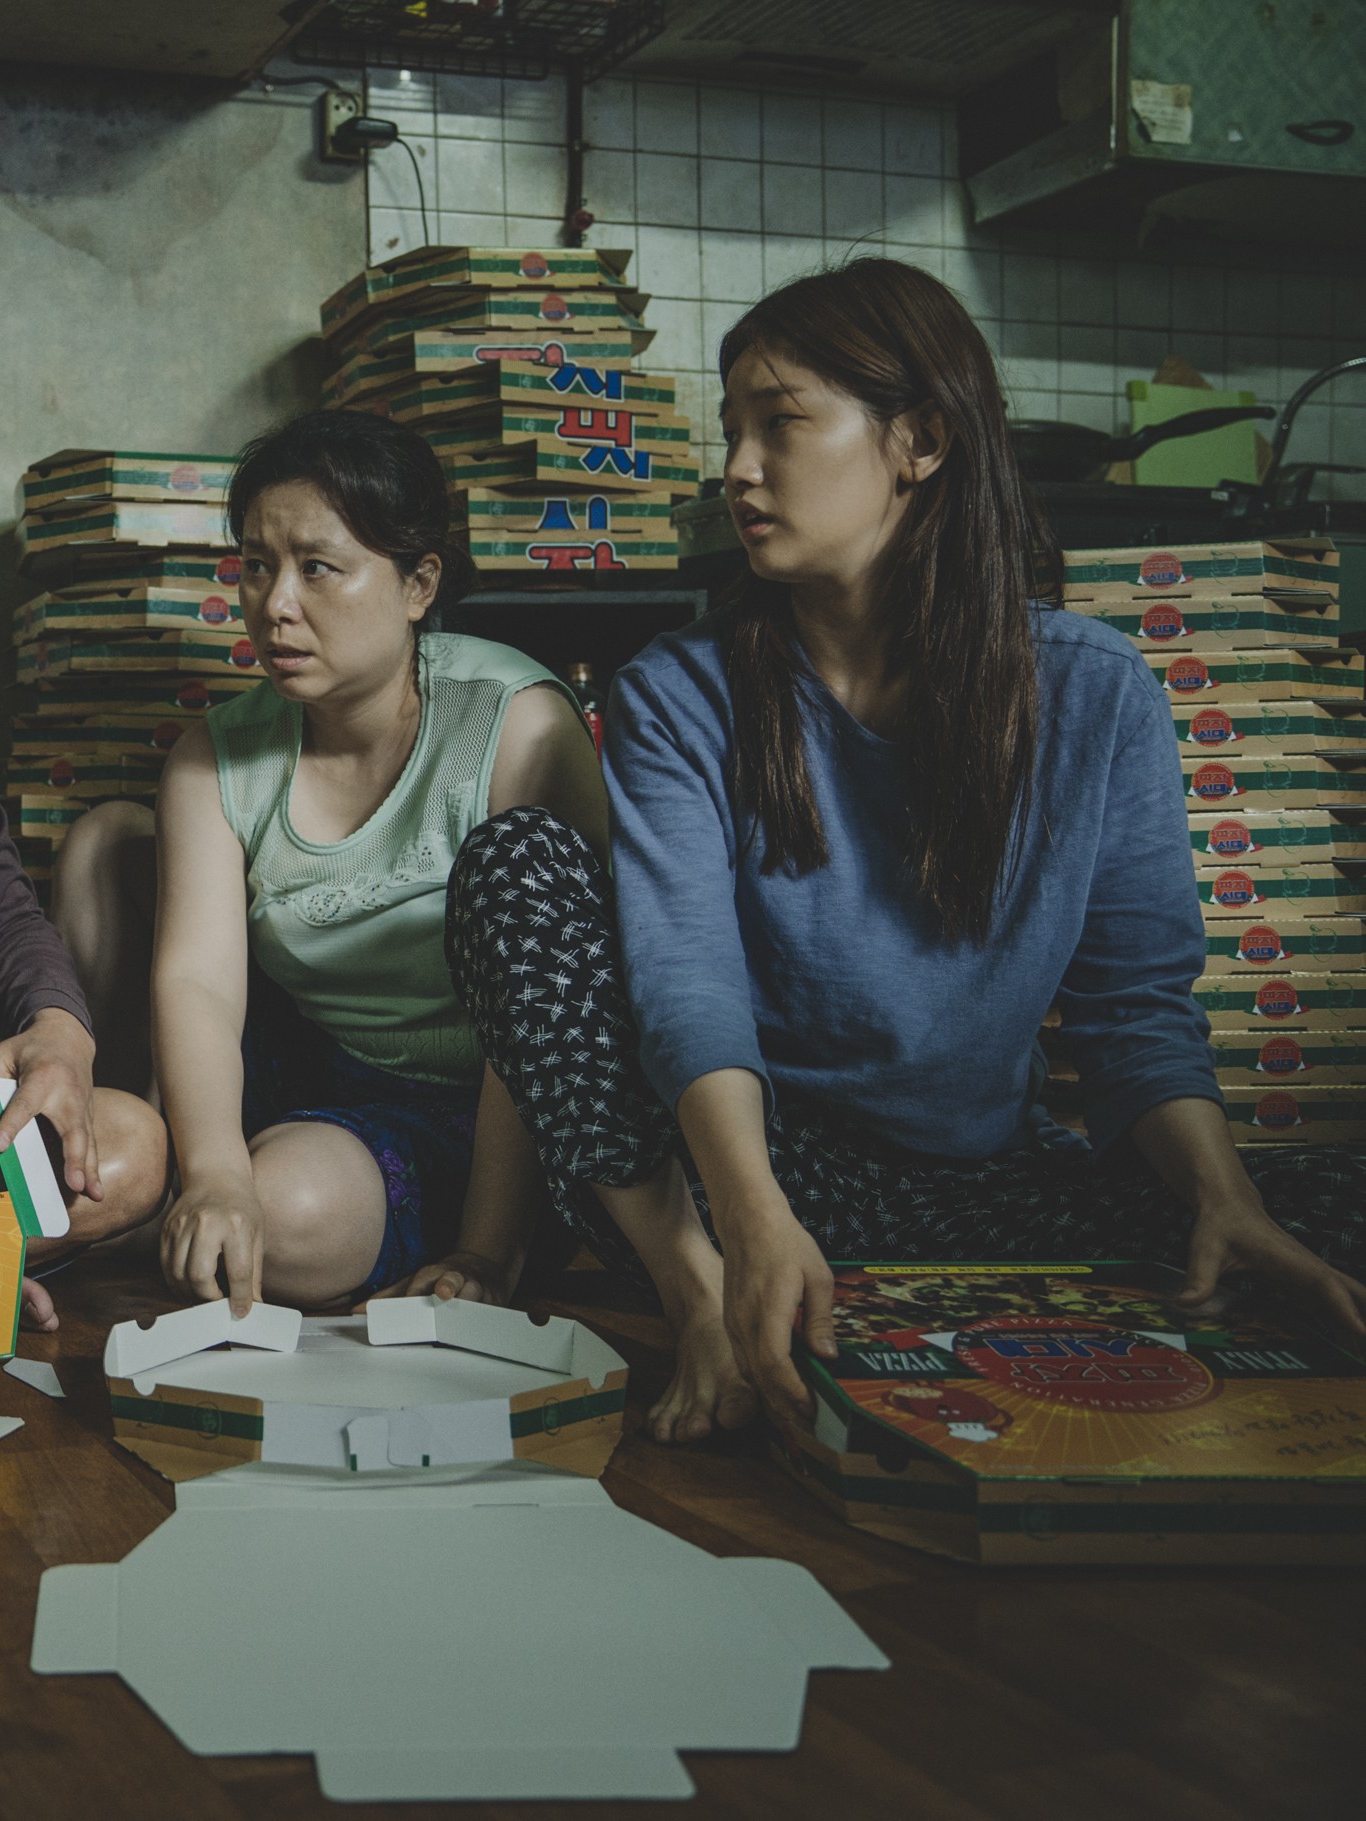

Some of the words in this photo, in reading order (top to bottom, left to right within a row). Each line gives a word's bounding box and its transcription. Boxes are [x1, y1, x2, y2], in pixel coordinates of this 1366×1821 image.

[1198, 729, 1225, 738] 시대
[1200, 783, 1227, 792] 시대
[982, 1339, 1137, 1358] 시대
[856, 1351, 948, 1372] PIZZA
[1213, 1350, 1311, 1370] ITALY
[1009, 1363, 1187, 1384] 피자
